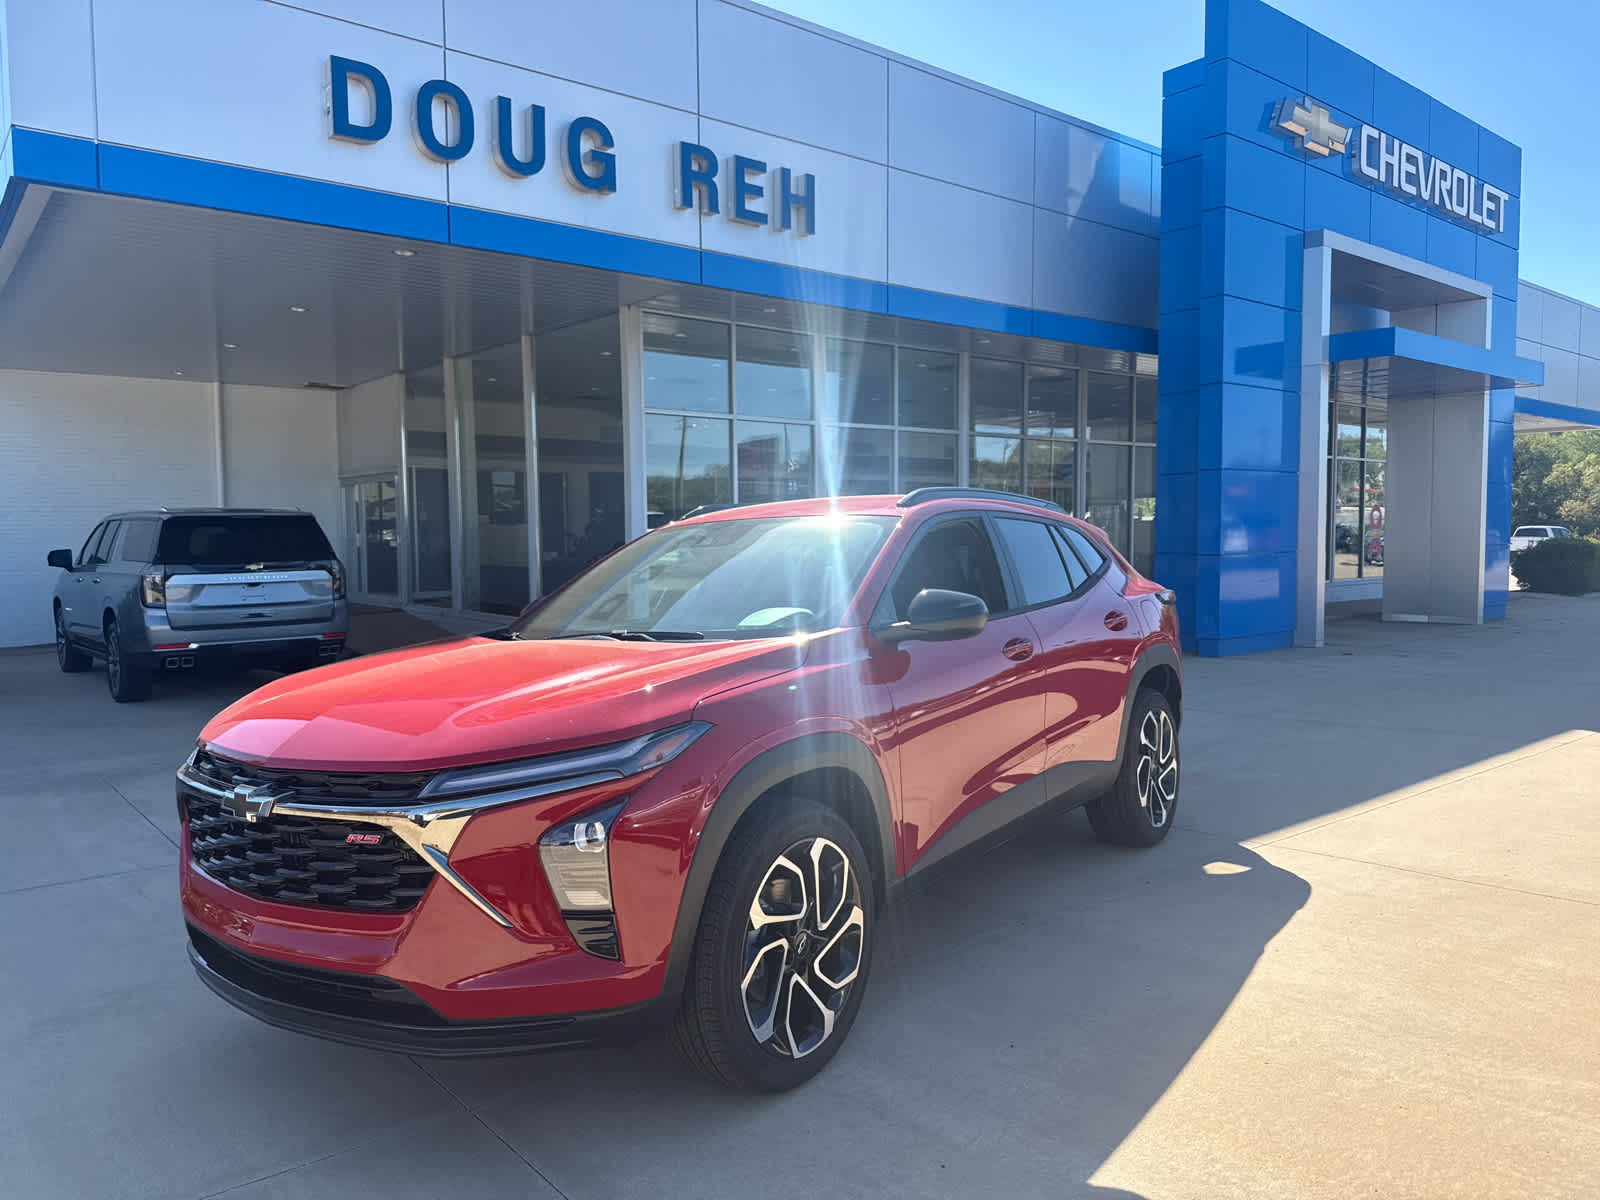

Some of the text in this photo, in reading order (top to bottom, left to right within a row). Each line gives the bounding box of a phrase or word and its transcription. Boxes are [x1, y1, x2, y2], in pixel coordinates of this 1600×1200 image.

[328, 55, 816, 236] DOUG REH
[1359, 124, 1509, 233] CHEVROLET
[346, 833, 381, 845] RS
